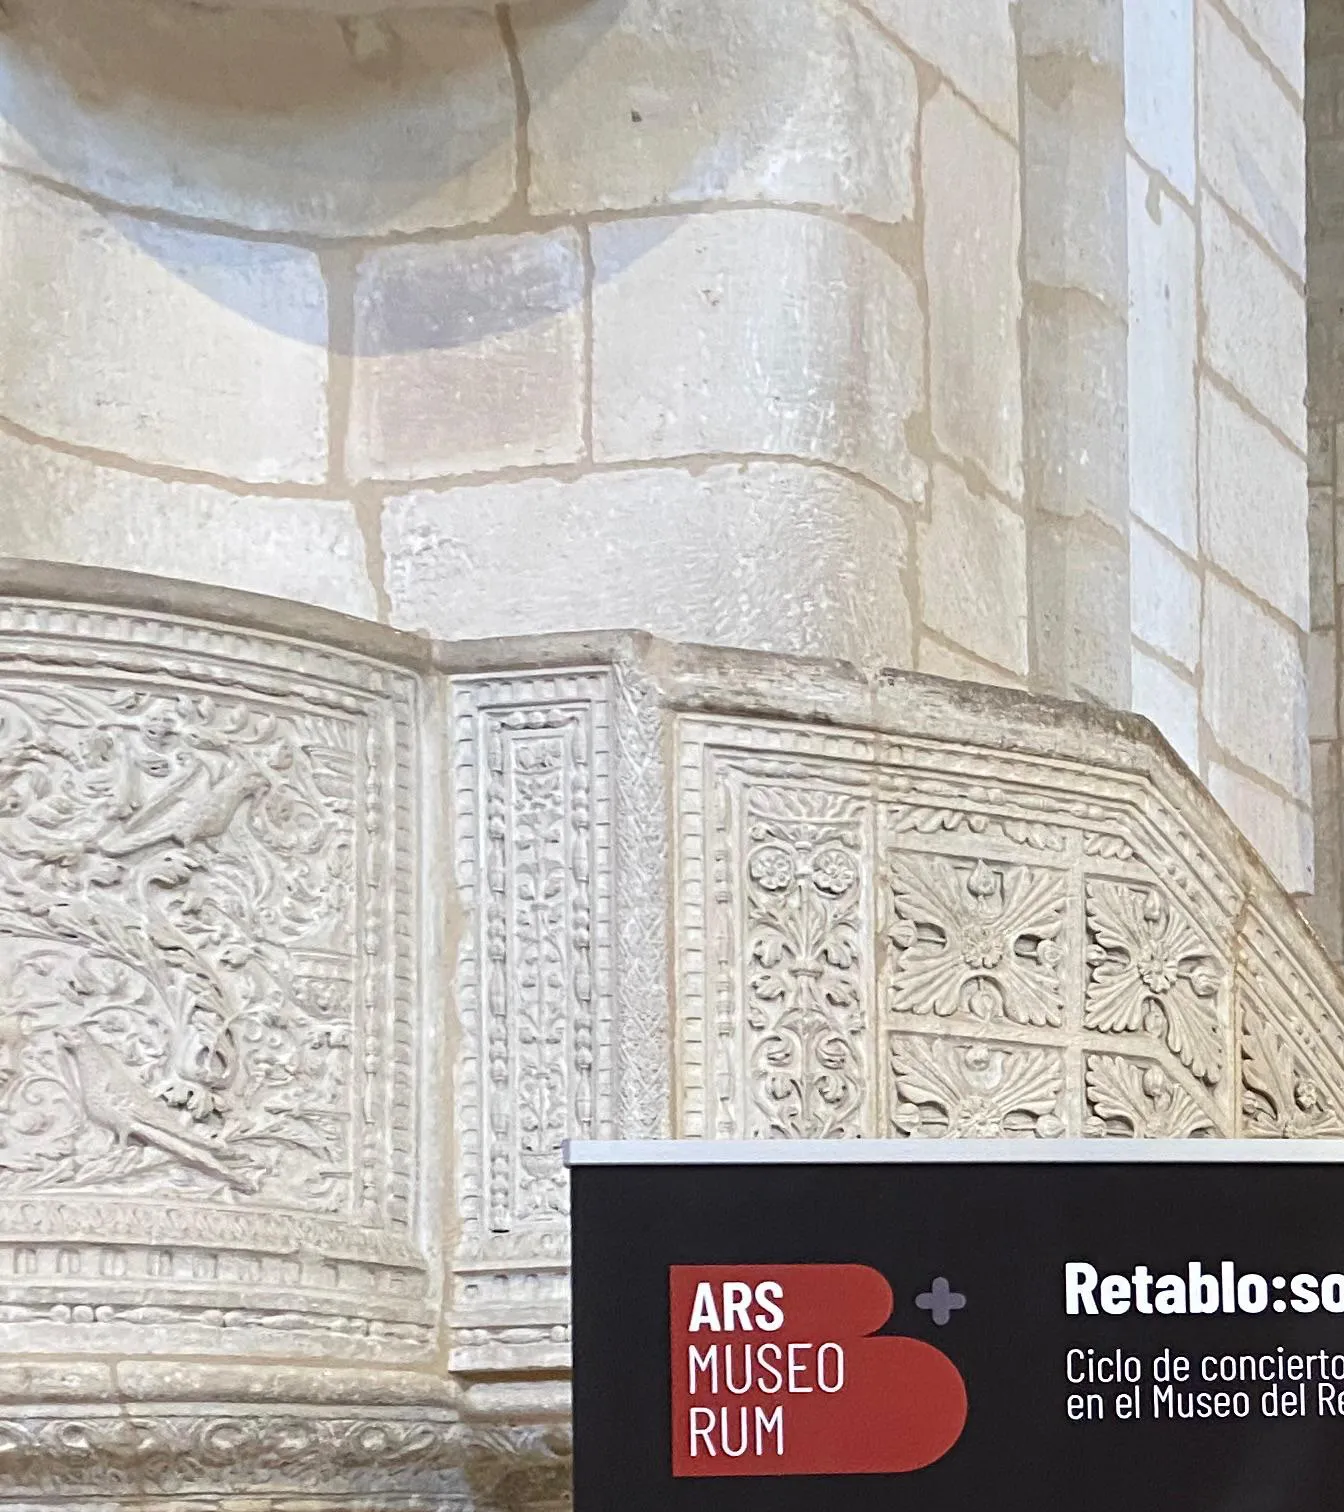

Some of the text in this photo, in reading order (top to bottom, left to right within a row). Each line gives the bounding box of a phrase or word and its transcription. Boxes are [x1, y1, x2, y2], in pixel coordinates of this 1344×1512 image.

[688, 1281, 784, 1332] ARS
[688, 1342, 845, 1394] MUSEO
[1066, 1348, 1142, 1383] Ciclo
[1153, 1348, 1190, 1382] de
[1066, 1393, 1103, 1420] en
[1115, 1386, 1141, 1418] el
[1154, 1384, 1250, 1418] Museo
[1261, 1384, 1305, 1417] del
[690, 1405, 784, 1457] RUM
